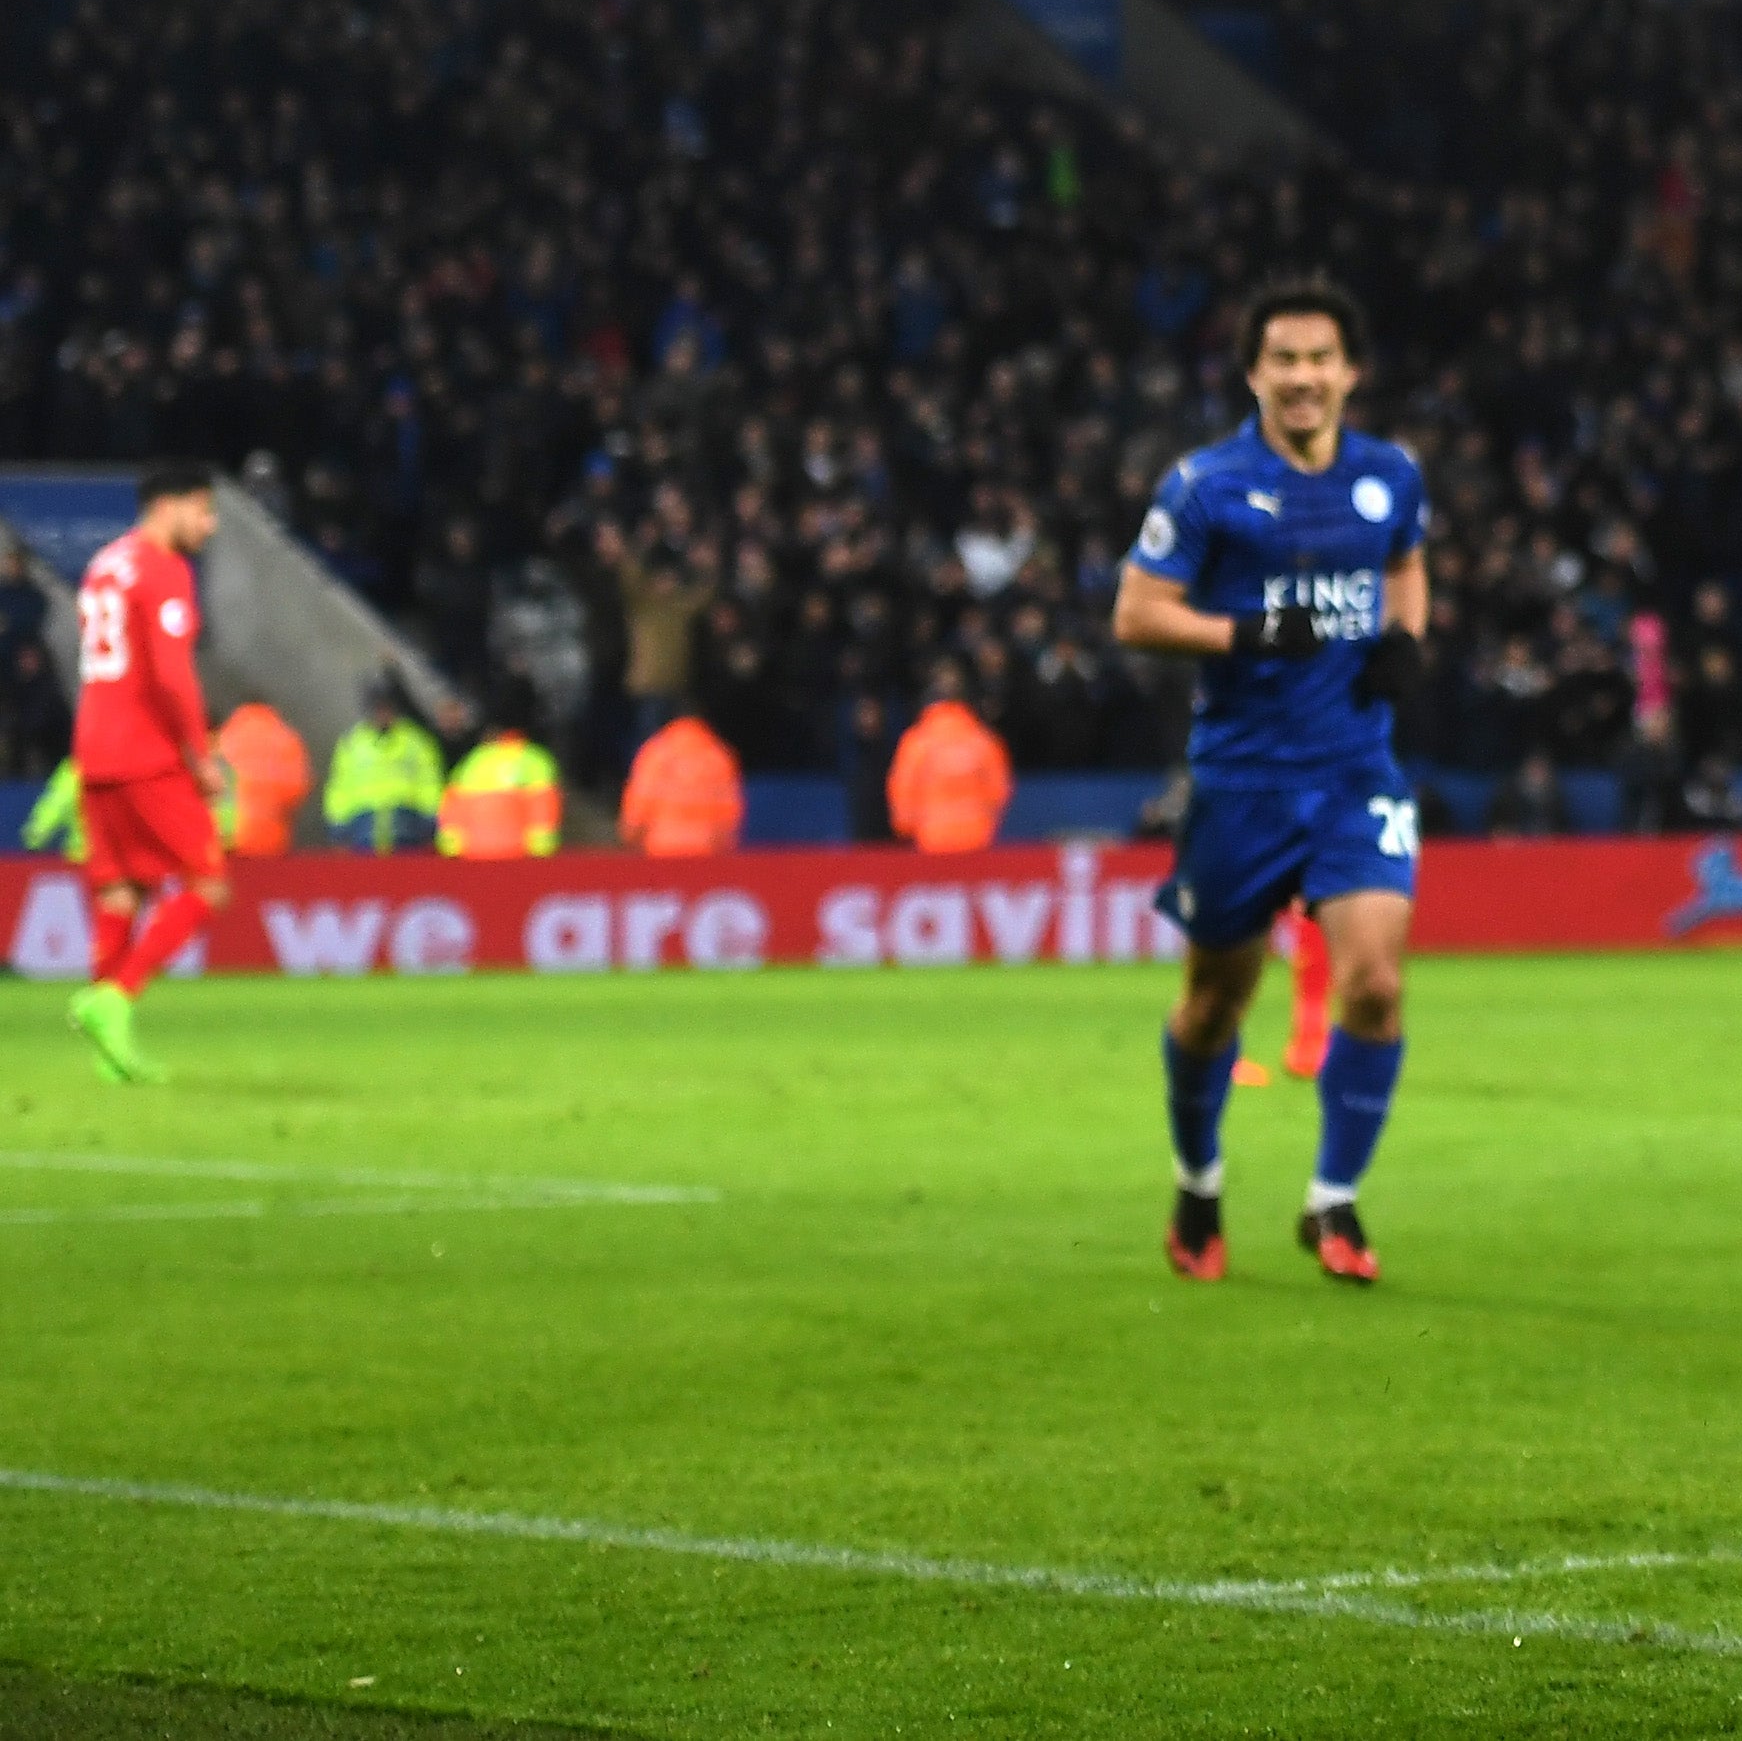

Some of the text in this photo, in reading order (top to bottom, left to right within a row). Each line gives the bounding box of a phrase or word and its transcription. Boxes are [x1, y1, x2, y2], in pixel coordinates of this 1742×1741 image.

[1263, 567, 1376, 612] KING
[258, 896, 474, 976] we
[523, 892, 768, 972] are
[812, 841, 1190, 968] savin
